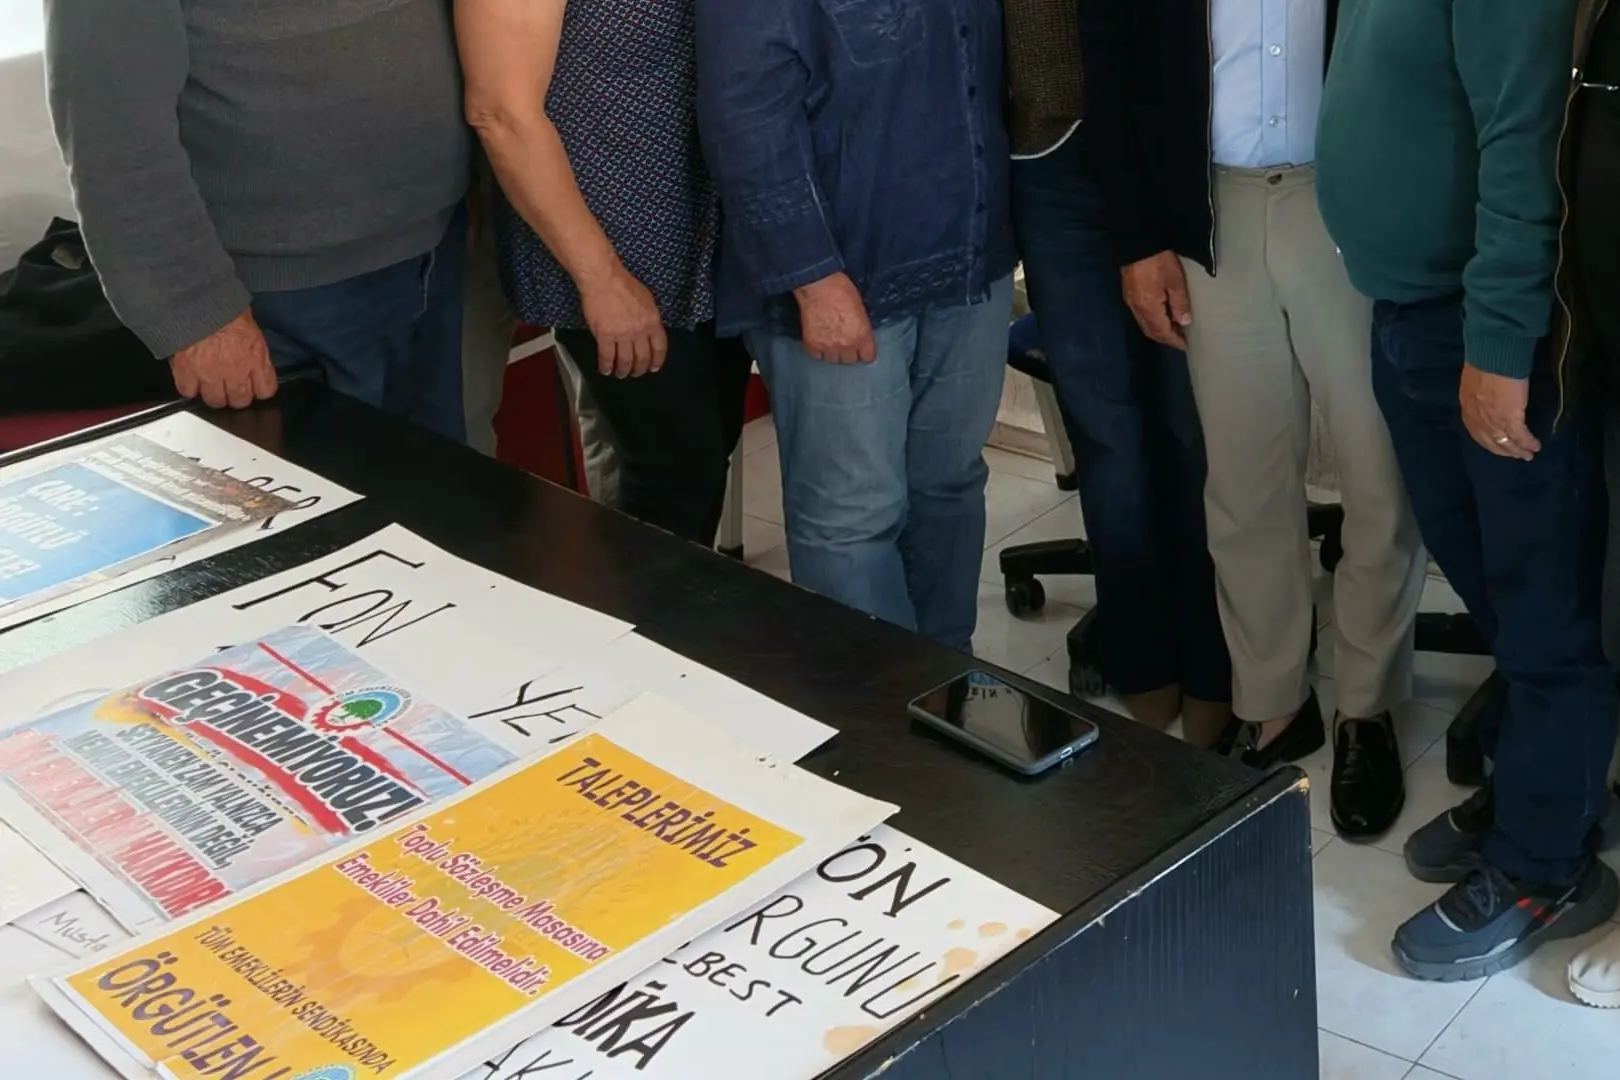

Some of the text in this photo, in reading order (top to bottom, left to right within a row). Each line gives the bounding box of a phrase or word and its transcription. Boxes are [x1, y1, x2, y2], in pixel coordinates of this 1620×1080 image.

[232, 549, 457, 648] FON
[142, 669, 425, 832] GEÇİNEMİYORUZ!
[468, 680, 603, 743] YE
[173, 762, 226, 793] ZAM
[555, 757, 758, 868] TALEPLERİMİZ
[337, 853, 552, 995] Emekliler Dahil Edilmelidir.
[398, 823, 609, 963] Toplu Sözleşme Masasına
[97, 951, 292, 1080] ÖRGÜTLEN
[195, 925, 399, 1075] TÜM EMEKLİLERİN SENDİKASINDA
